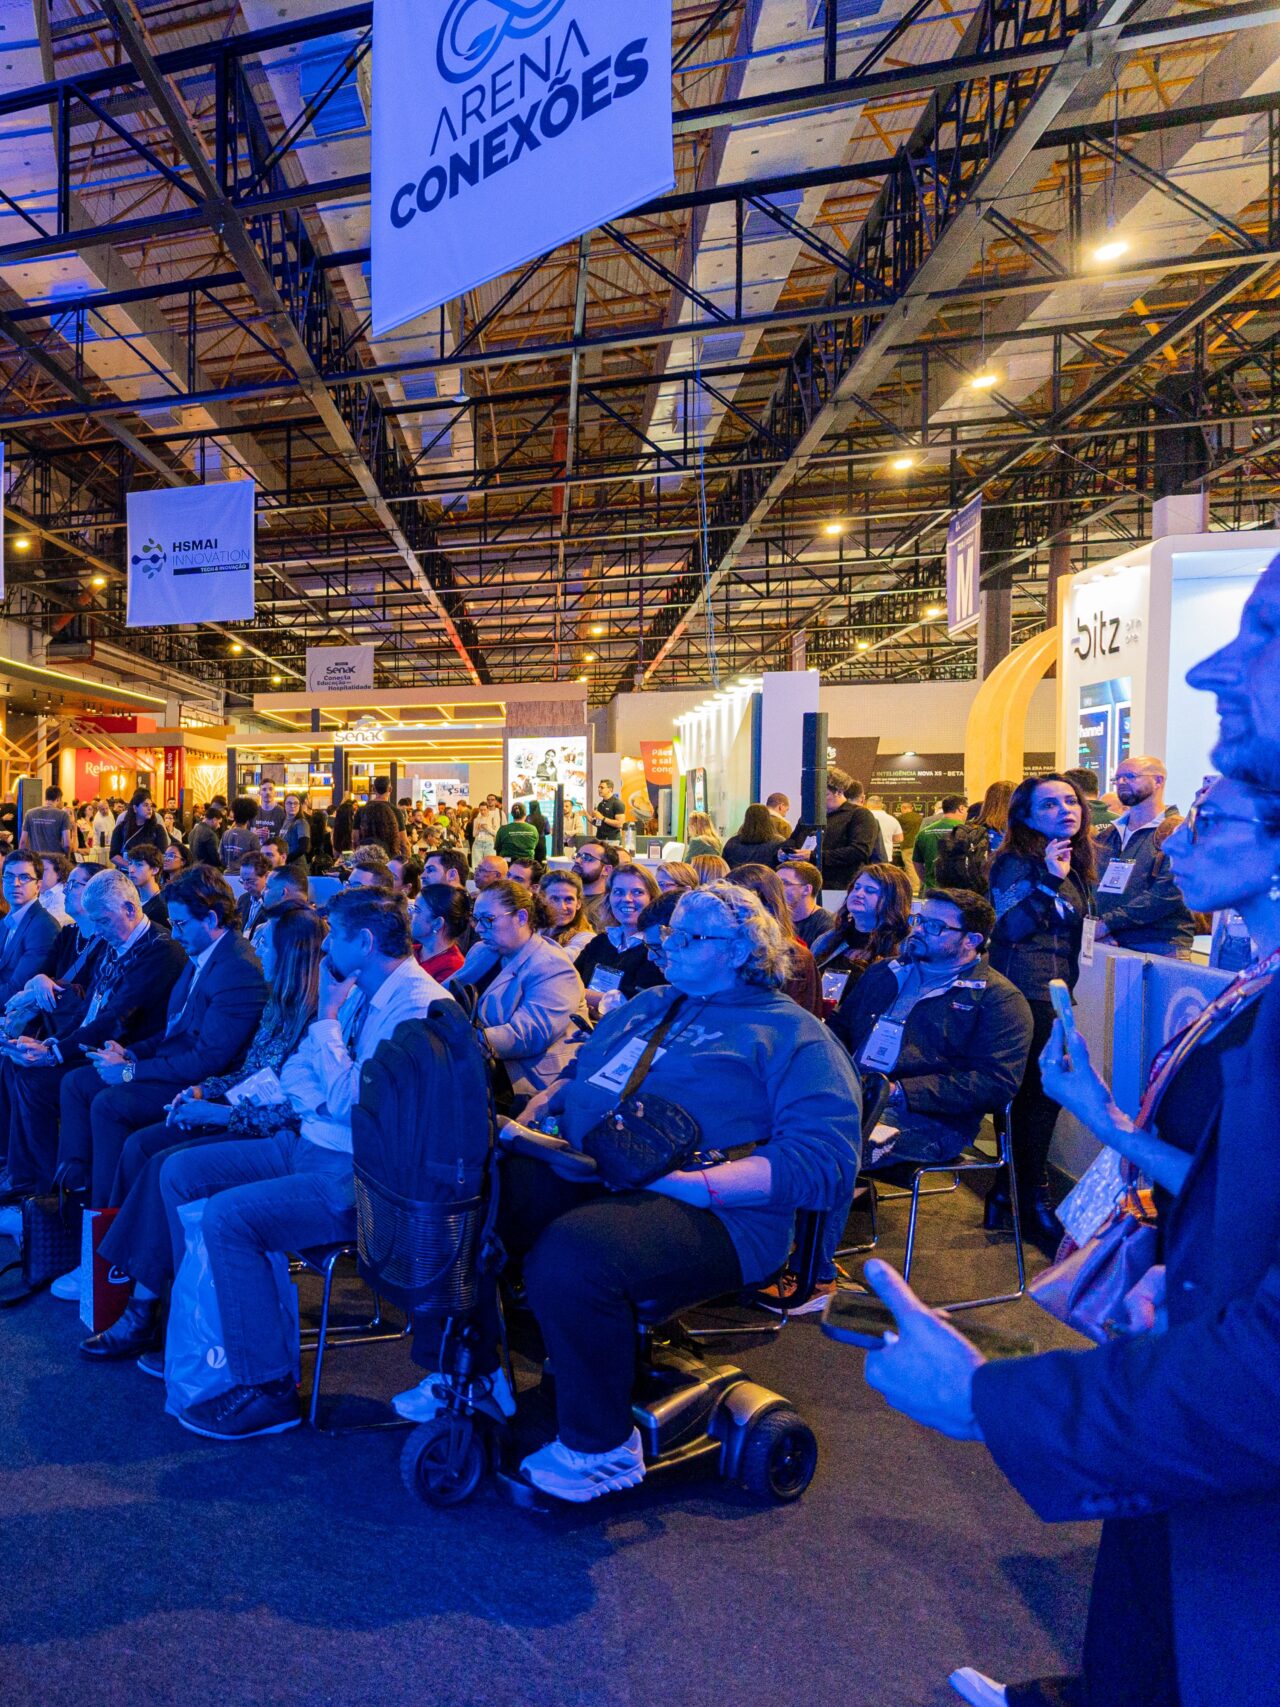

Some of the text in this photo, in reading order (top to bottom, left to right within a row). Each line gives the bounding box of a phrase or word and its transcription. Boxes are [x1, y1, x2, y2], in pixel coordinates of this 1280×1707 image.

[429, 18, 590, 157] ARENA
[390, 37, 649, 229] CONEXÕES
[172, 538, 218, 553] HSMAI
[172, 549, 250, 567] INNOVATION
[956, 546, 974, 622] M
